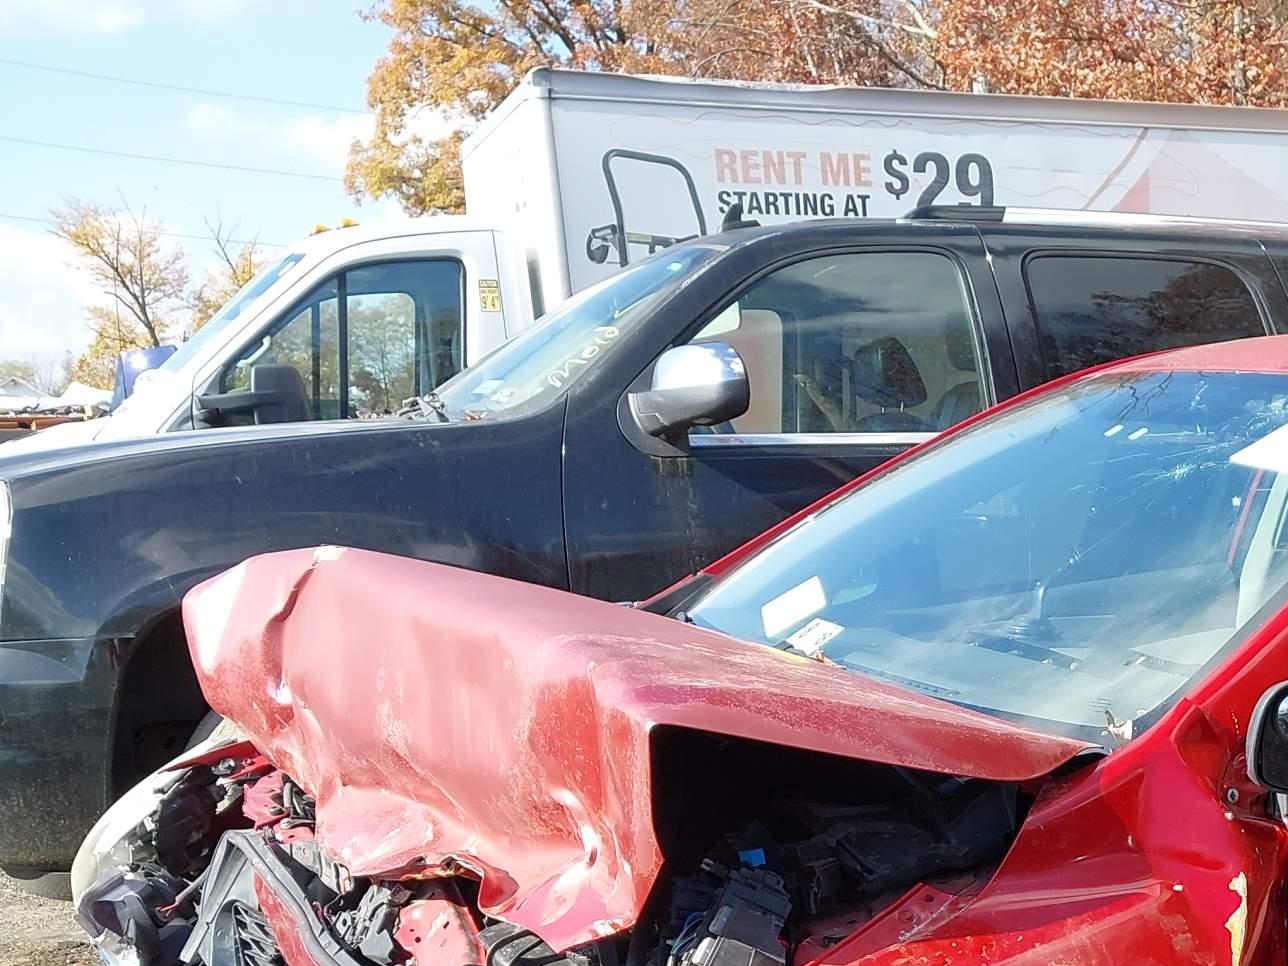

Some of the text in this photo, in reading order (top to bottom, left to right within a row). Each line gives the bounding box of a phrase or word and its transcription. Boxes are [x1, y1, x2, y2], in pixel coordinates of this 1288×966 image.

[714, 148, 995, 208] RENT ME $29
[717, 190, 871, 218] STARTING AT
